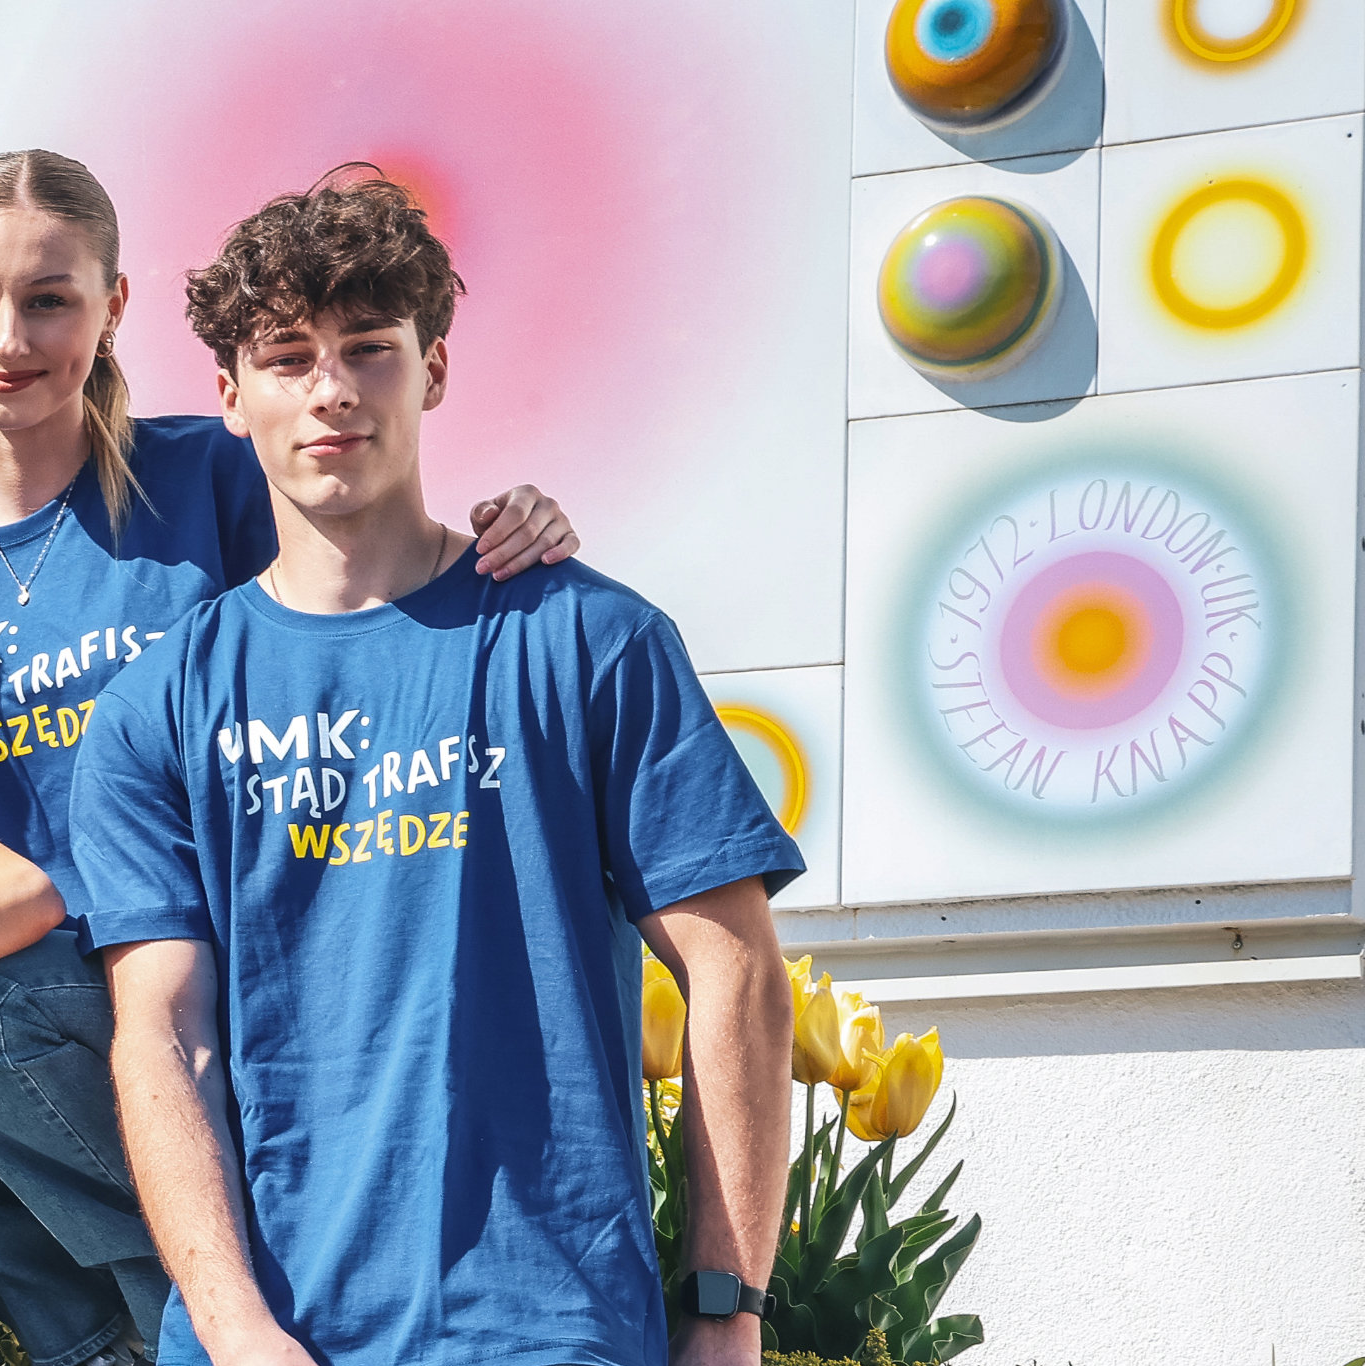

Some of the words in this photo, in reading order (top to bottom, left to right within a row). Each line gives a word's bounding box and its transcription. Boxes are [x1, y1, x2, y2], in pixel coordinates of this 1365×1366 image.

[939, 514, 1034, 631] 1972
[1048, 479, 1239, 575] LONDON
[1200, 574, 1262, 638] UK
[7, 625, 166, 704] TRAFIS
[217, 709, 370, 764] UMK:
[928, 643, 1068, 800] STEFAN
[1091, 652, 1248, 803] KNAPP
[246, 767, 347, 818] STĄD
[362, 734, 506, 808] TRAFSZ
